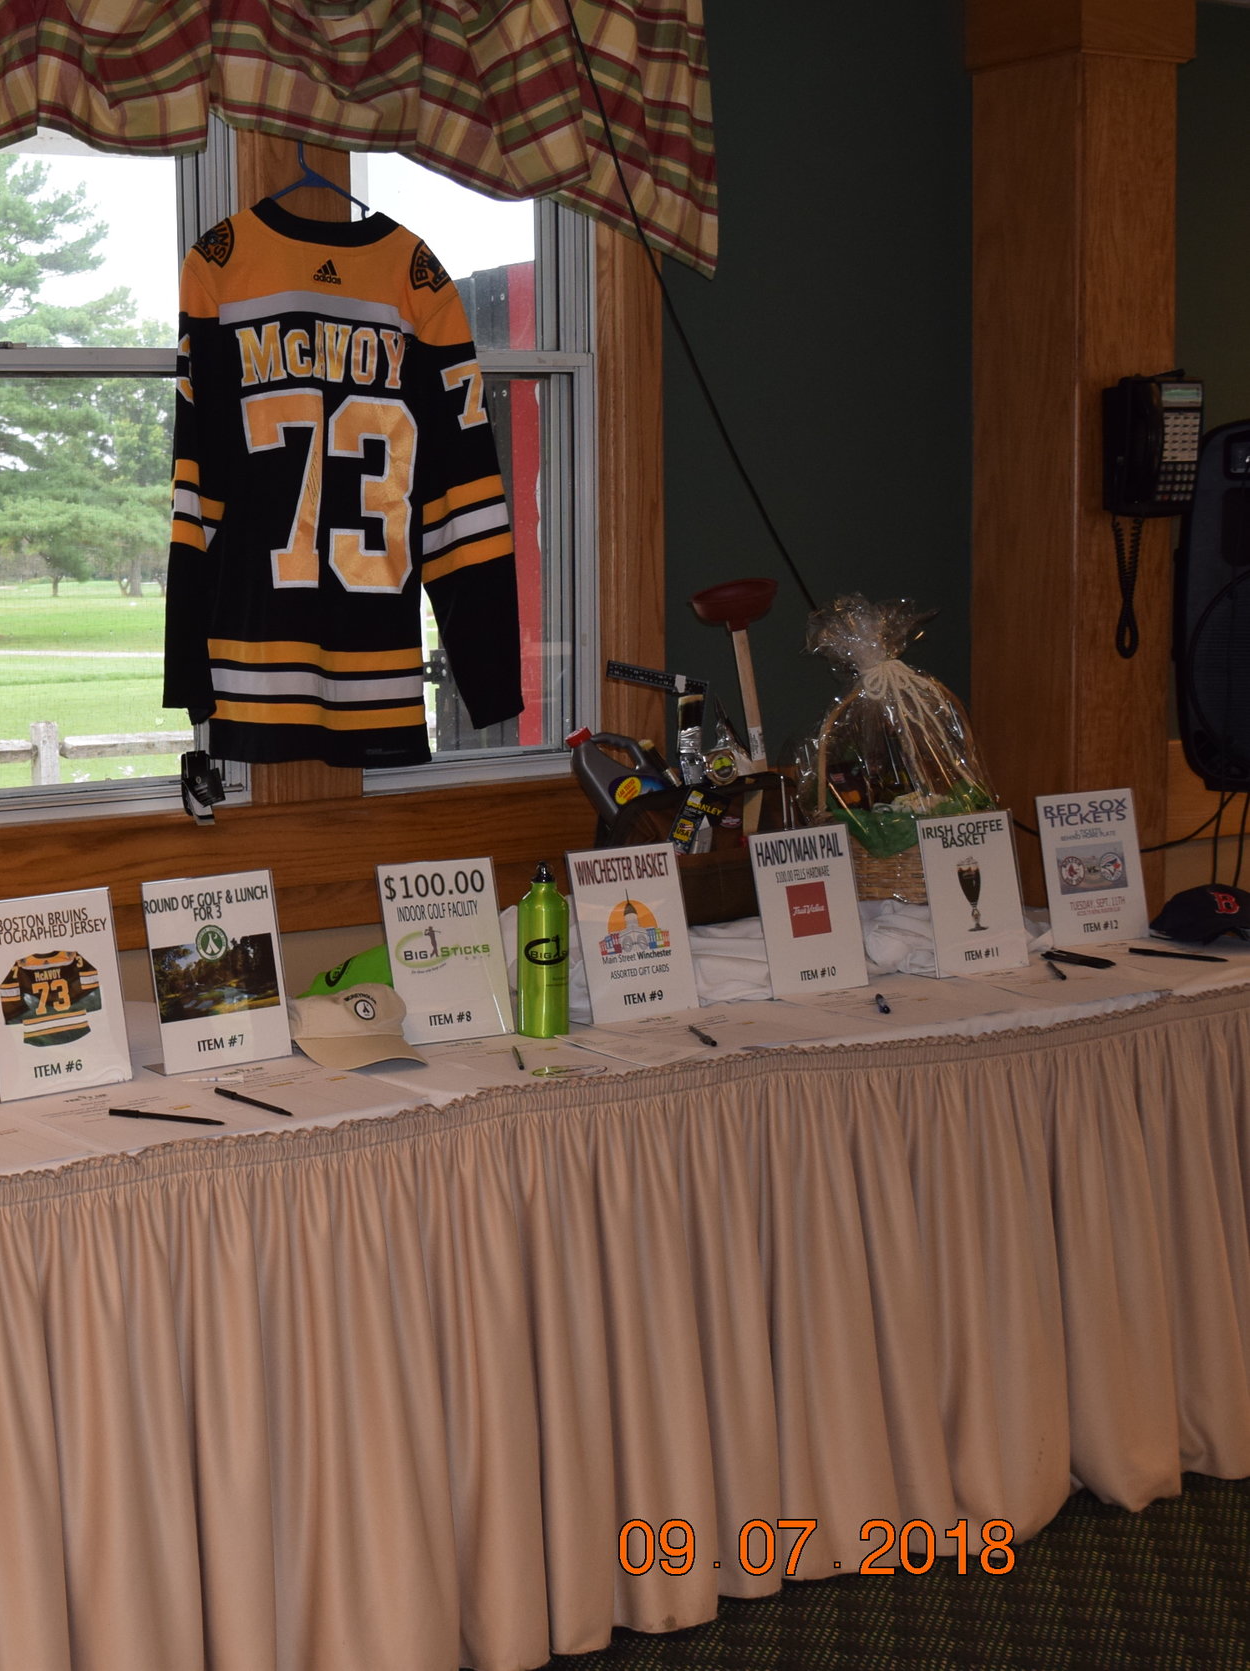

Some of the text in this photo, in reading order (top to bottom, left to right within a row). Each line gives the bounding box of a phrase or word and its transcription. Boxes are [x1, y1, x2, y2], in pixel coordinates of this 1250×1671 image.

[313, 273, 342, 285] adidas
[441, 358, 489, 431] 7
[240, 387, 418, 595] 73
[1043, 797, 1128, 819] RED SOX
[921, 818, 1004, 840] IRISH COFFEE
[1048, 809, 1127, 829] TICKETS
[755, 832, 844, 868] HANDYMAN PAIL
[941, 832, 987, 849] BASKET
[574, 852, 669, 887] WINCHESTER BASKET
[384, 868, 486, 901] $100.00
[143, 885, 269, 915] ROUND OF GOLF & LUNCH
[1210, 891, 1240, 915] B
[47, 907, 89, 926] BRUINS
[193, 904, 223, 922] FOR 3
[396, 899, 479, 923] INDOOR GOLF FACILITY
[69, 917, 108, 938] JERSEY
[1083, 918, 1119, 934] ITEM #12
[403, 949, 429, 961] BIG
[440, 943, 491, 957] STICKS
[602, 948, 672, 966] Main Street Winchester
[964, 950, 983, 962] ITEM
[610, 963, 670, 981] ASSORTED GIFT CARDS
[800, 966, 837, 982] ITEM #10
[32, 978, 73, 1016] 73
[623, 989, 664, 1006] ITEM #9
[429, 1011, 472, 1027] ITEM #8
[197, 1033, 245, 1053] ITEM #7
[33, 1058, 83, 1079] ITEM #6
